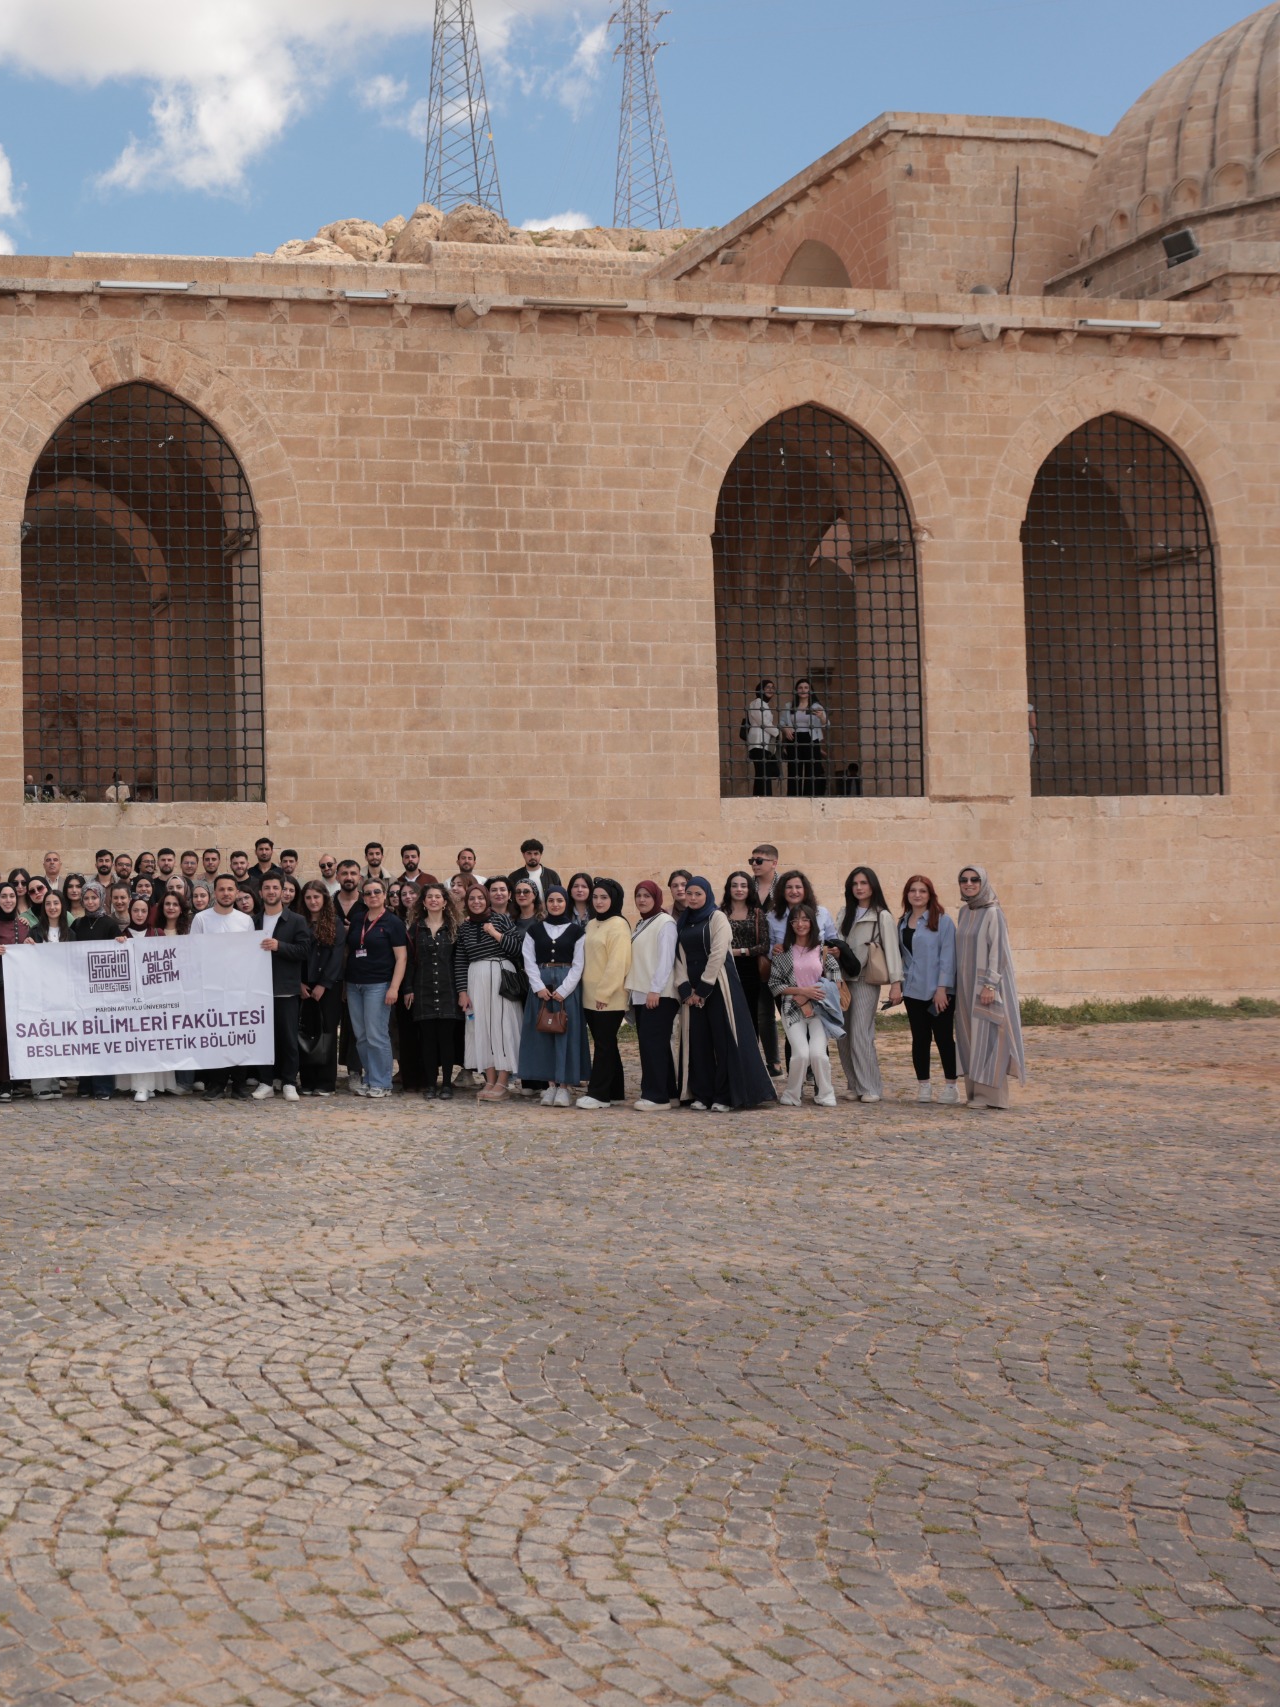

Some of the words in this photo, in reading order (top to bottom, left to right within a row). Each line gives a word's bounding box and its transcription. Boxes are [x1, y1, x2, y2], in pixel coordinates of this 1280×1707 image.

[142, 948, 176, 963] AHLAK
[147, 960, 173, 973] BİLGİ
[142, 970, 180, 986] ÜRETİM
[16, 1018, 78, 1038] SAĞLIK
[83, 1011, 168, 1034] BİLİMLERİ
[173, 1005, 265, 1030] FAKÜLTESİ
[27, 1041, 100, 1058] BESLENME
[105, 1040, 121, 1054] VE
[126, 1035, 196, 1052] DİYETETİK
[200, 1030, 256, 1048] BÖLÜMÜ
